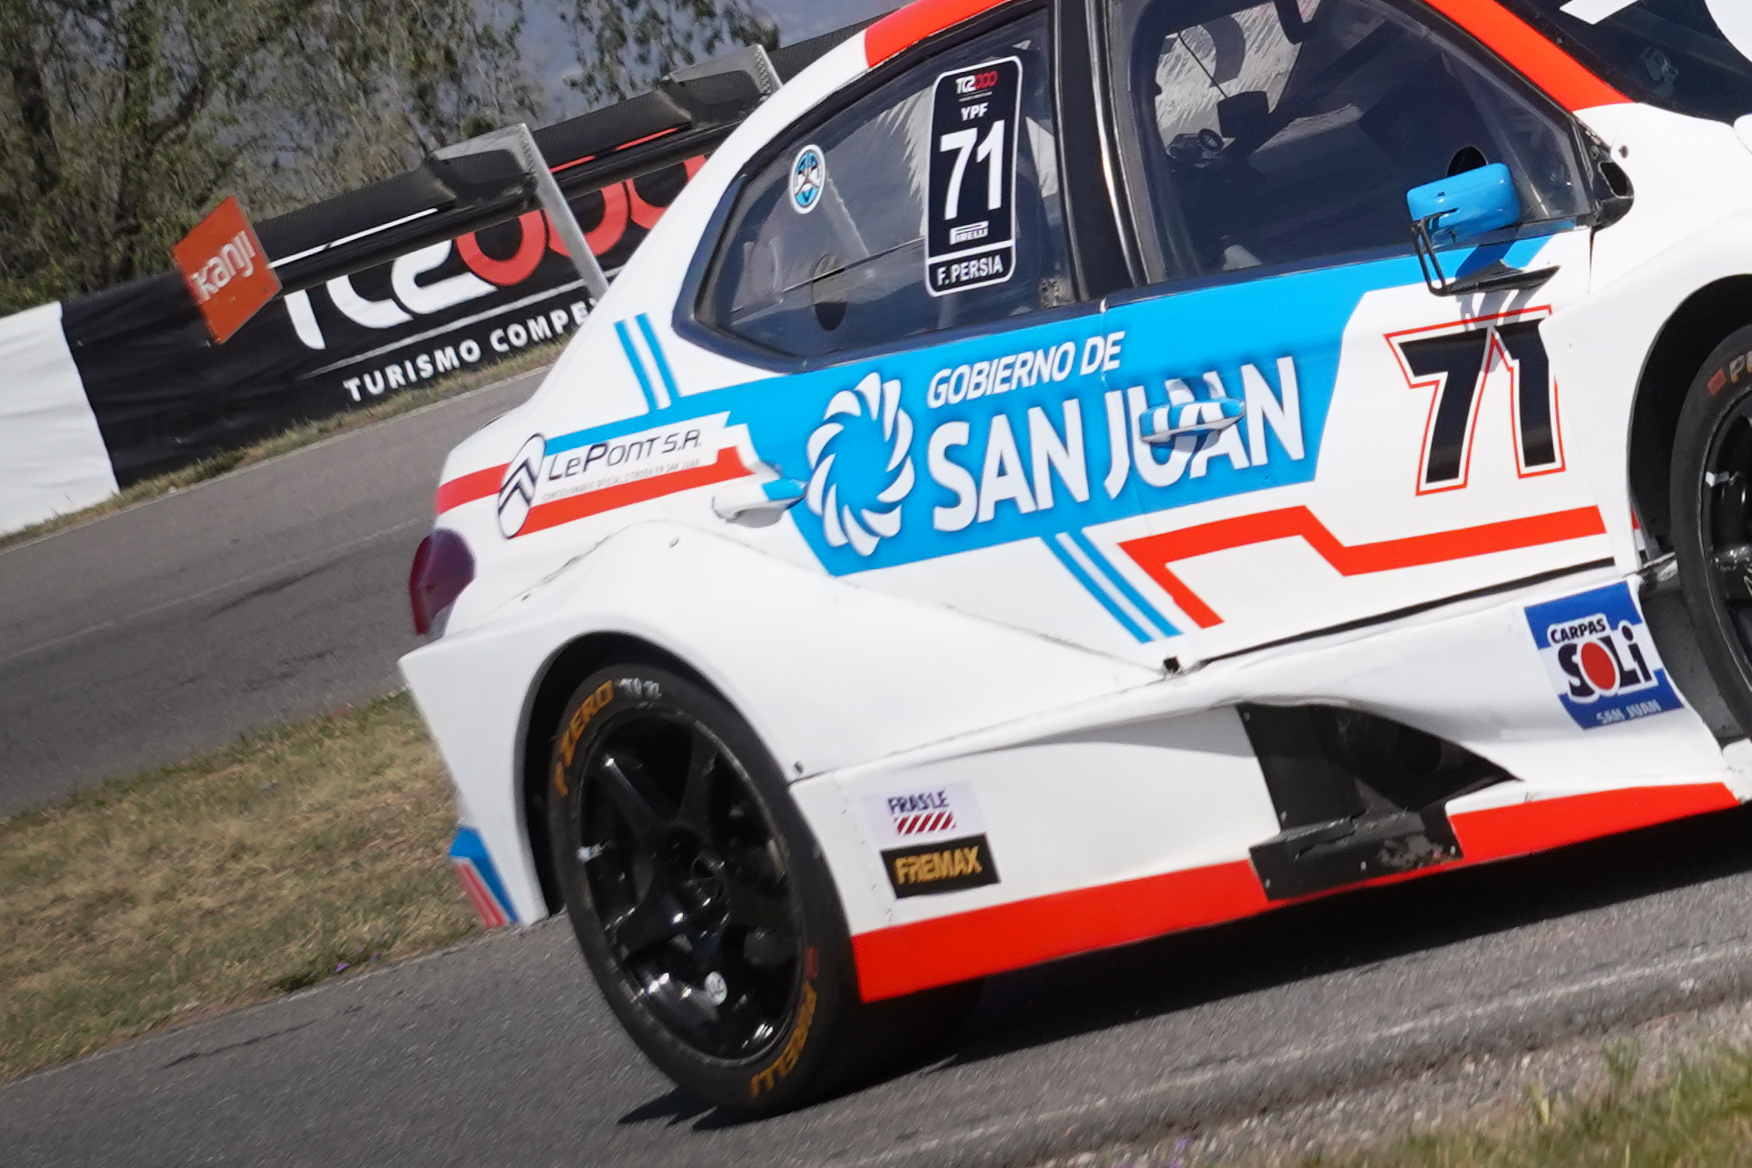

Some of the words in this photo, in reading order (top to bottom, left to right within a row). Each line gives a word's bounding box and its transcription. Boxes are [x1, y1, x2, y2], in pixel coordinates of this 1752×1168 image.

[961, 102, 988, 121] YPF
[940, 120, 1005, 220] 71
[950, 220, 990, 245] PIRELLI
[191, 230, 256, 303] kanji
[342, 339, 481, 402] TURISMO
[927, 341, 1075, 409] GOBIERNO
[1080, 331, 1126, 374] DE
[1386, 306, 1565, 495] 71
[928, 398, 1090, 532] SAN
[1104, 355, 1304, 500] JUAN
[1550, 618, 1607, 644] CARPAS
[1596, 707, 1625, 725] SAN
[1626, 699, 1661, 718] JUAN
[894, 846, 983, 885] FREMAX
